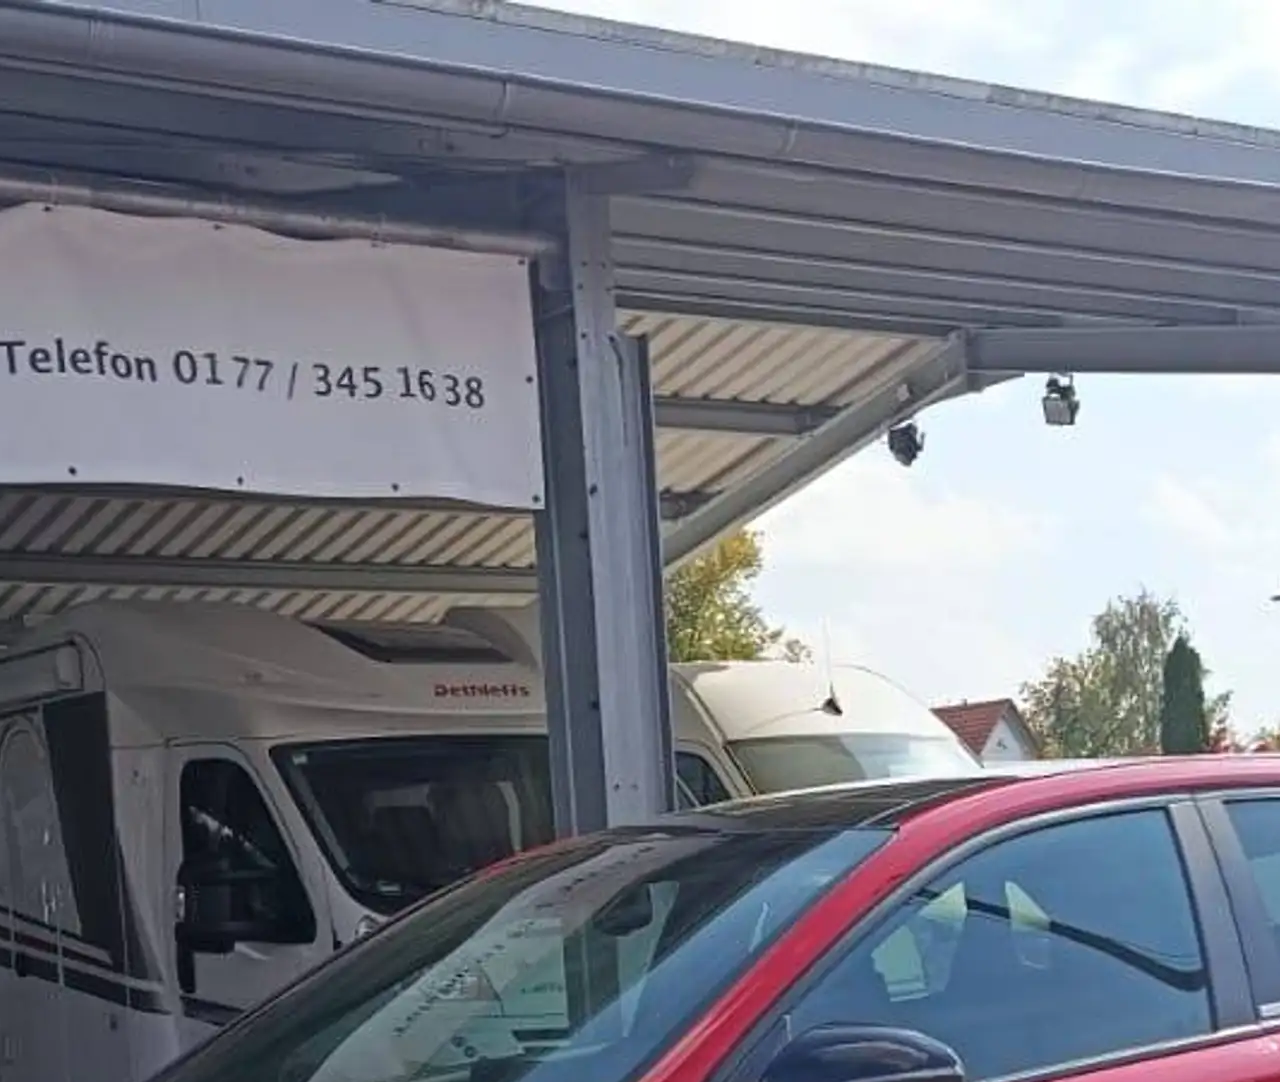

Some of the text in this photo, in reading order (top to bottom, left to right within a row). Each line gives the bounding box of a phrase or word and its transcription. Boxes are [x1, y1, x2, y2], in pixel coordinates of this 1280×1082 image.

[173, 349, 274, 393] 0177
[287, 362, 299, 399] /
[313, 363, 383, 399] 345
[399, 366, 485, 409] 1638
